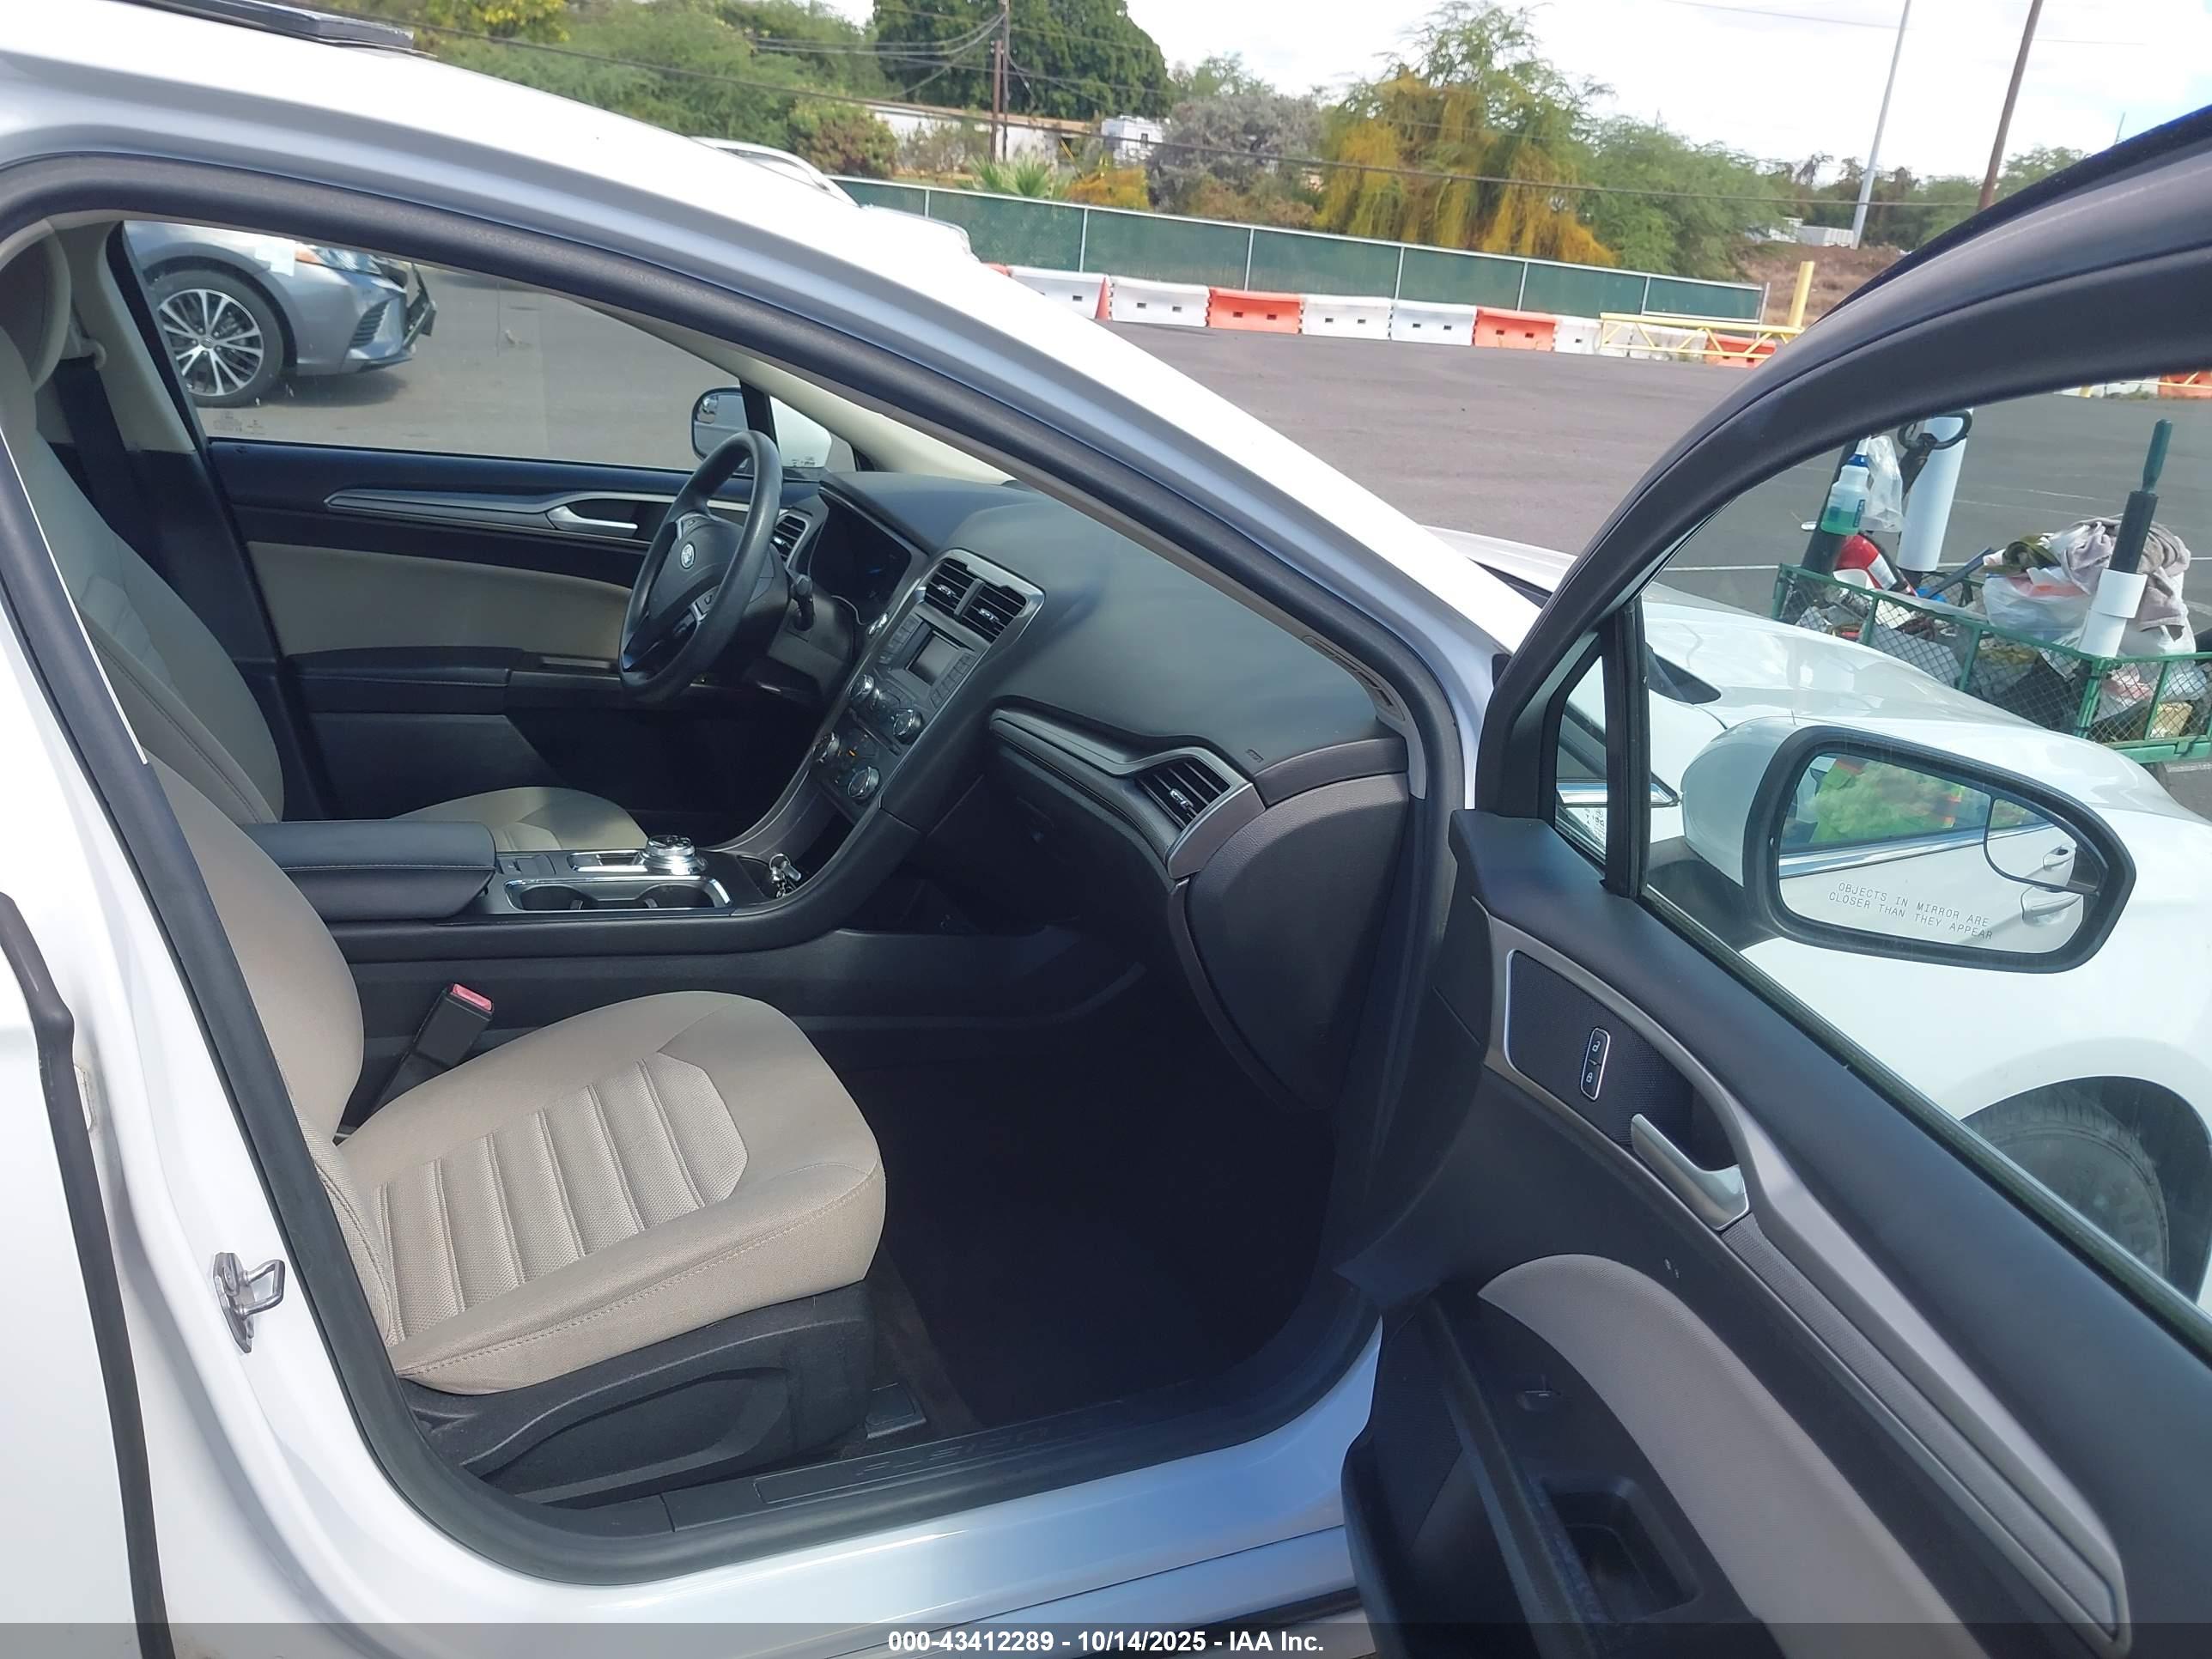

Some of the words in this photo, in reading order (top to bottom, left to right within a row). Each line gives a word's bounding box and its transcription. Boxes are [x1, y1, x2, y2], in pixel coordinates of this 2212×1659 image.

[1828, 891, 1870, 909] CLOSER
[1878, 904, 1906, 918] THAN
[1914, 913, 1942, 927] THEY
[1948, 921, 1993, 940] APPEAR
[1838, 882, 1887, 902] OBJECTS
[1895, 896, 1909, 908] IN
[1916, 902, 1960, 921] MIRROR
[1966, 914, 1989, 927] ARE
